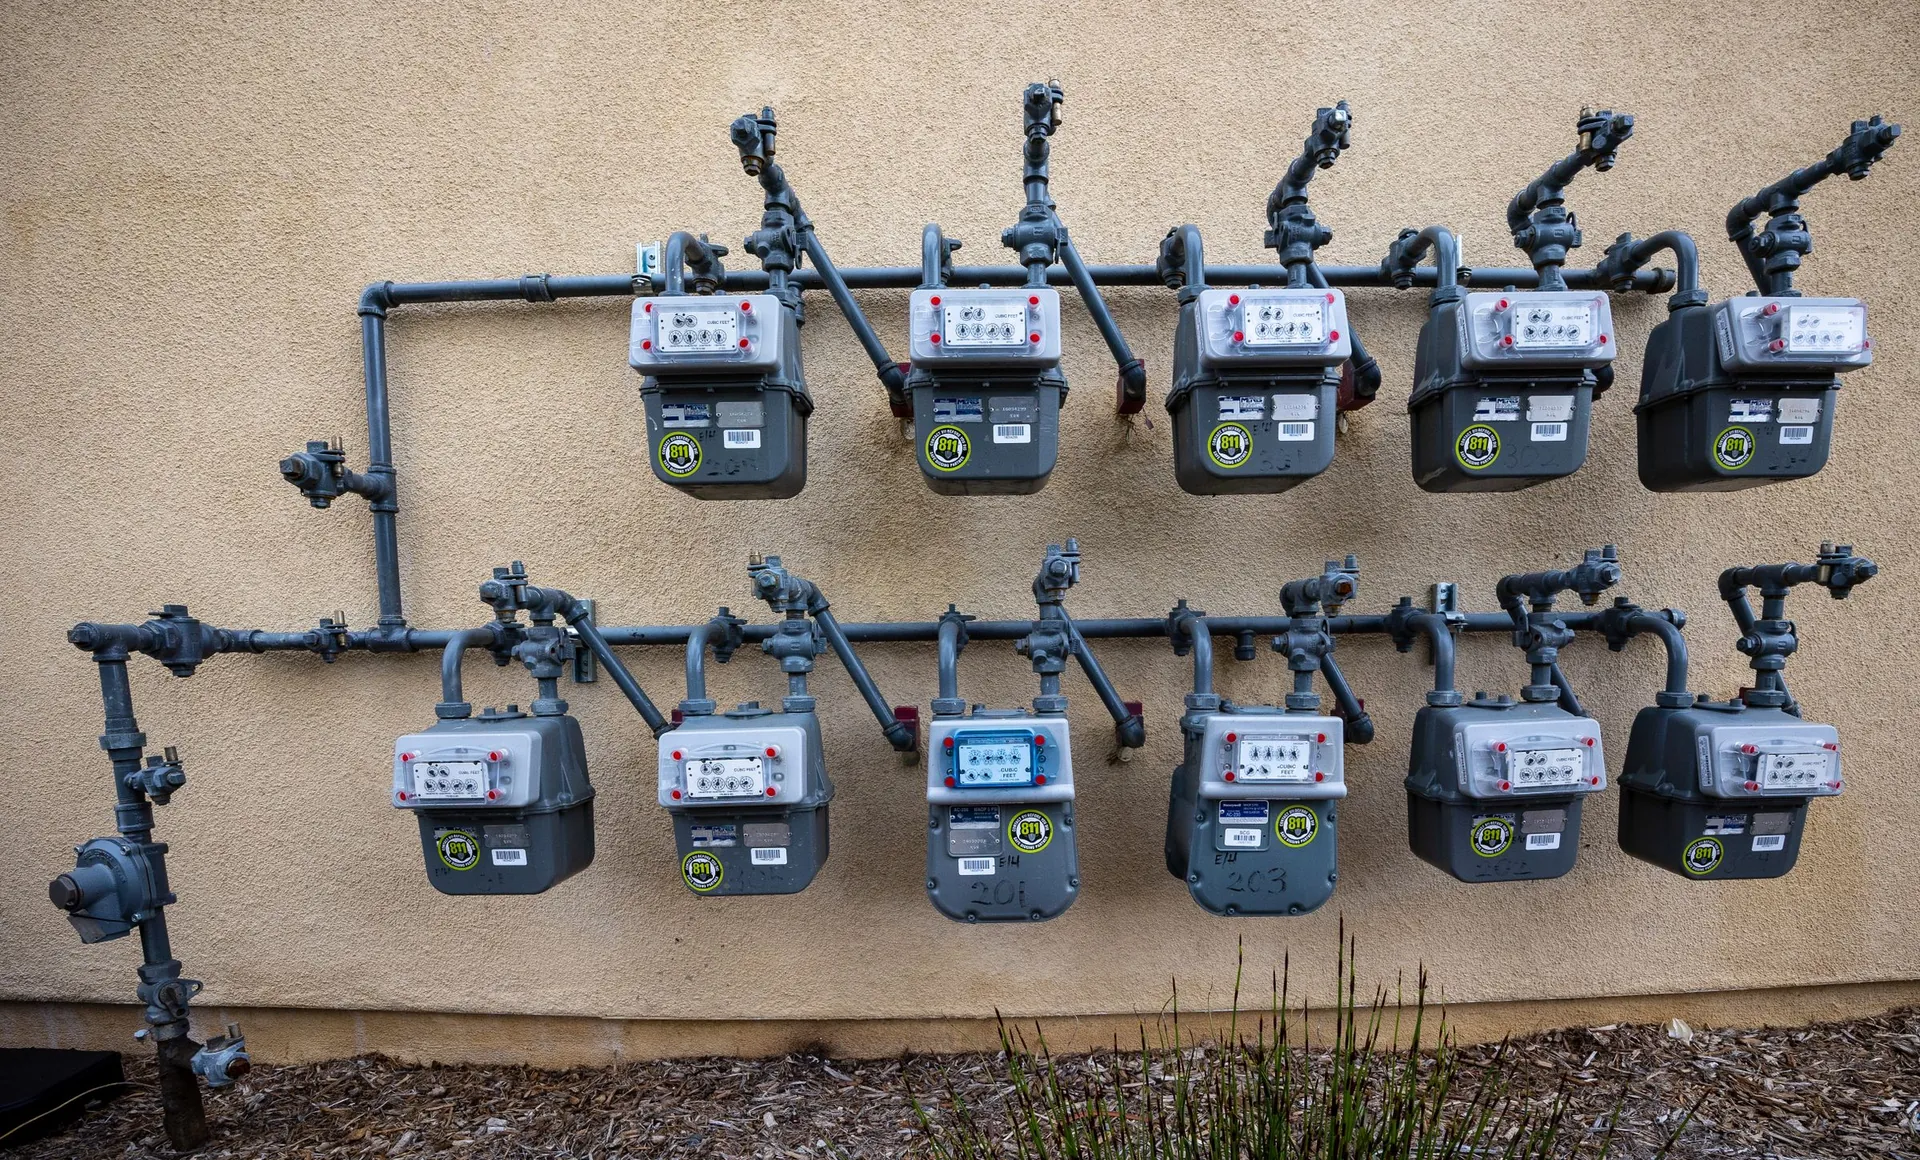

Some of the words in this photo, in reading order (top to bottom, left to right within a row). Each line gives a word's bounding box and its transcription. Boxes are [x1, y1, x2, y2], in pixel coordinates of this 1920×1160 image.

[938, 438, 958, 452] 811
[1220, 436, 1240, 450] 811
[1470, 436, 1488, 450] 811
[1726, 438, 1744, 452] 811
[670, 444, 688, 458] 811
[1020, 822, 1040, 836] 811
[1288, 816, 1306, 830] 811
[1484, 830, 1500, 840] 811
[450, 842, 466, 854] 811
[1696, 848, 1712, 860] 811
[692, 862, 710, 874] 811
[1226, 868, 1286, 893] 203
